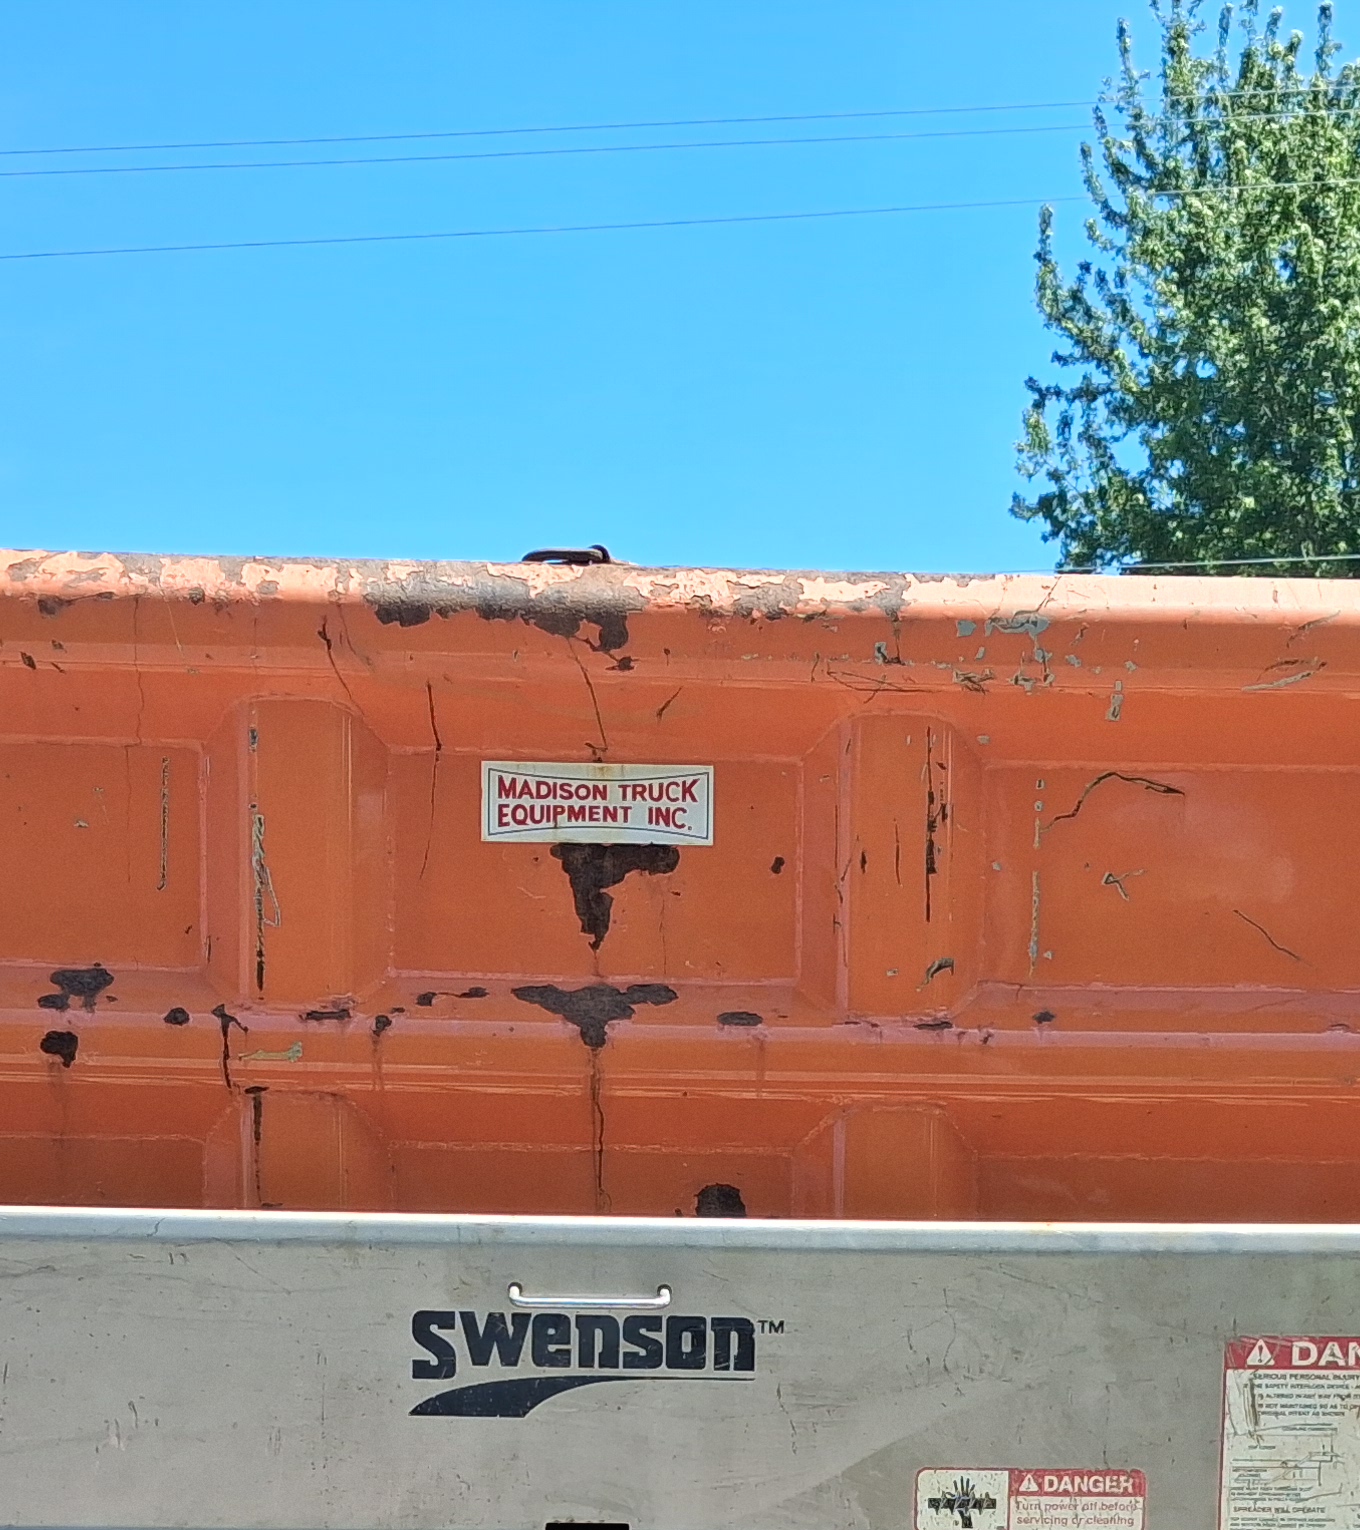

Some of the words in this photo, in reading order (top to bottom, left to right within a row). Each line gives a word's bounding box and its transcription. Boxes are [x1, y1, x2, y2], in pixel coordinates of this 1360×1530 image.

[497, 775, 608, 801] MADISON
[618, 778, 701, 803] TRUCK
[497, 803, 633, 828] EQUIPMENT
[648, 806, 693, 831] INC.
[1289, 1373, 1331, 1381] PERSONAL
[1044, 1475, 1134, 1493] DANGER
[1015, 1501, 1042, 1511] Turn
[1044, 1502, 1079, 1513] power
[1081, 1502, 1098, 1512] off
[1100, 1502, 1137, 1512] before
[1016, 1516, 1069, 1528] servicing
[1072, 1517, 1085, 1526] or
[1086, 1515, 1135, 1527] cleaning
